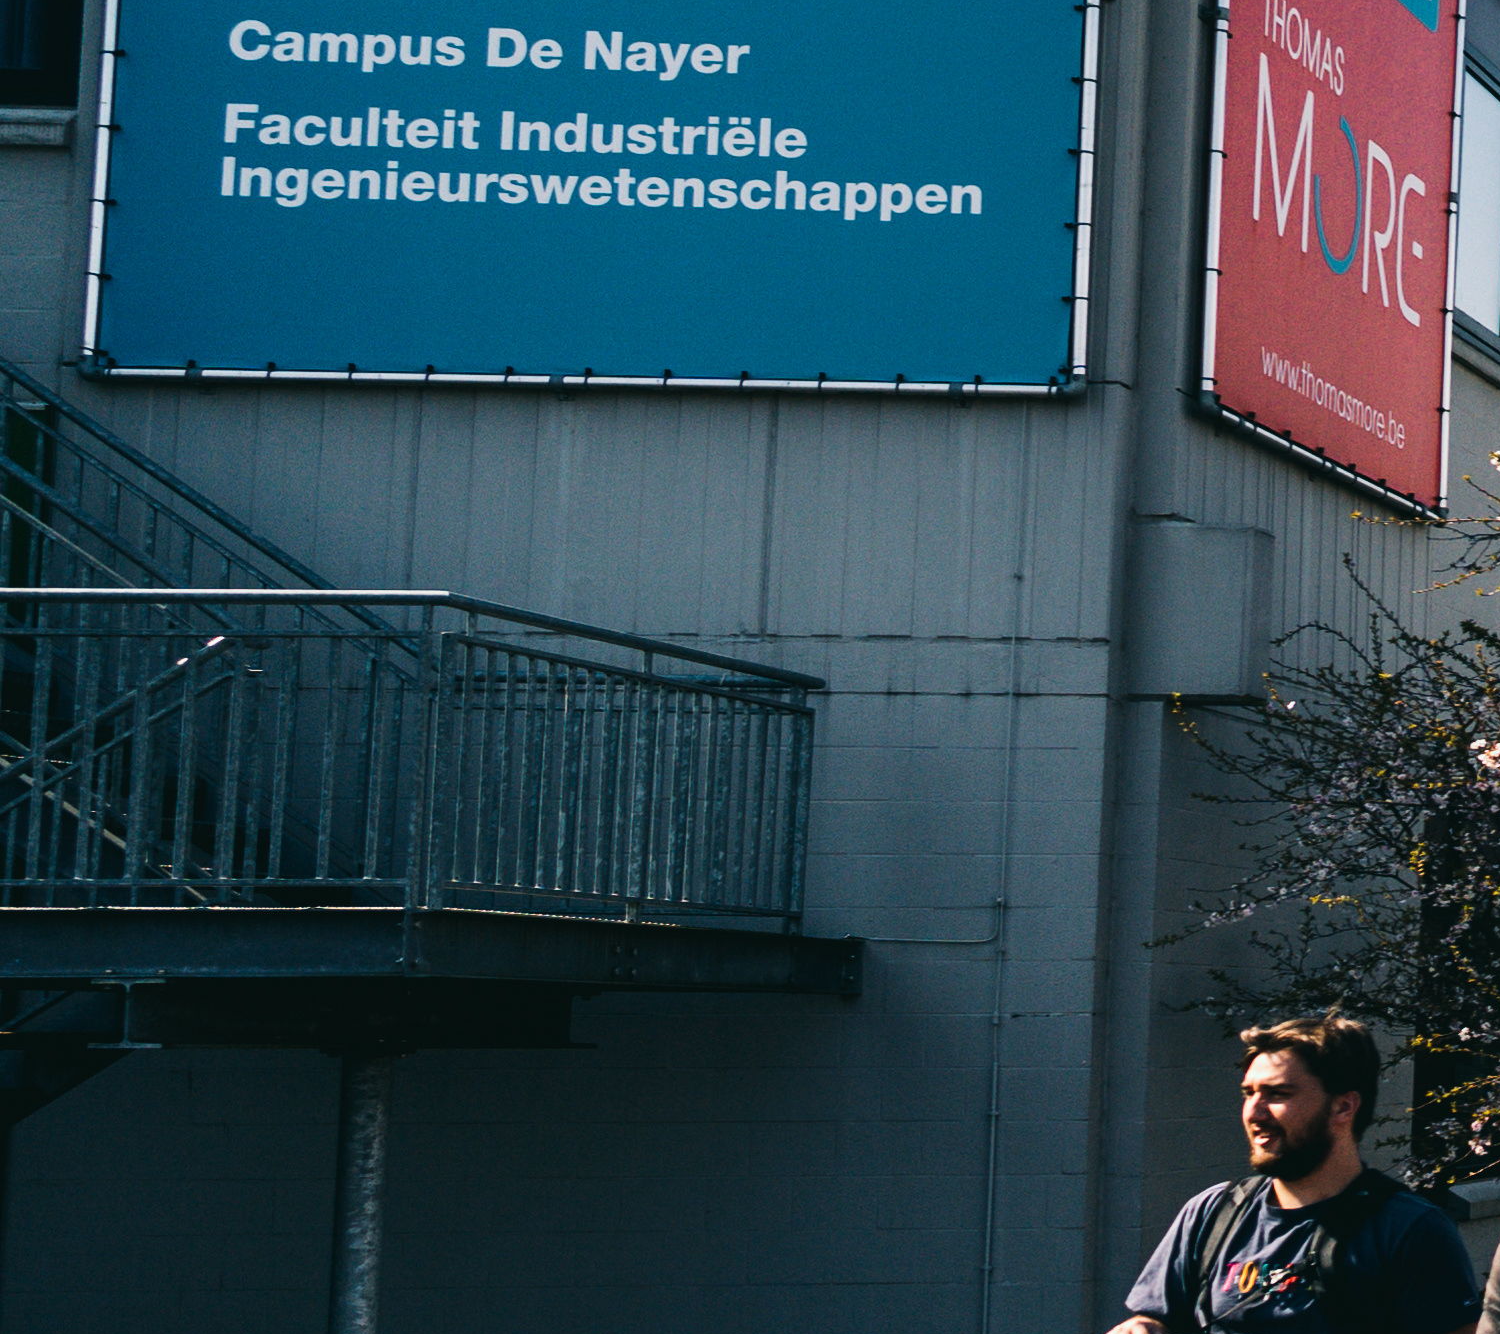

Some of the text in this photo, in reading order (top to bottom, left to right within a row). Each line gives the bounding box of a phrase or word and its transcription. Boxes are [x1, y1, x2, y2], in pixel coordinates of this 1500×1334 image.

[228, 19, 751, 81] Campus De Nayer
[223, 103, 809, 159] Faculteit Industriële
[220, 156, 983, 222] Ingenieurswetenschappen
[1252, 52, 1426, 328] MORE
[1261, 346, 1406, 450] www.thomasmore.be
